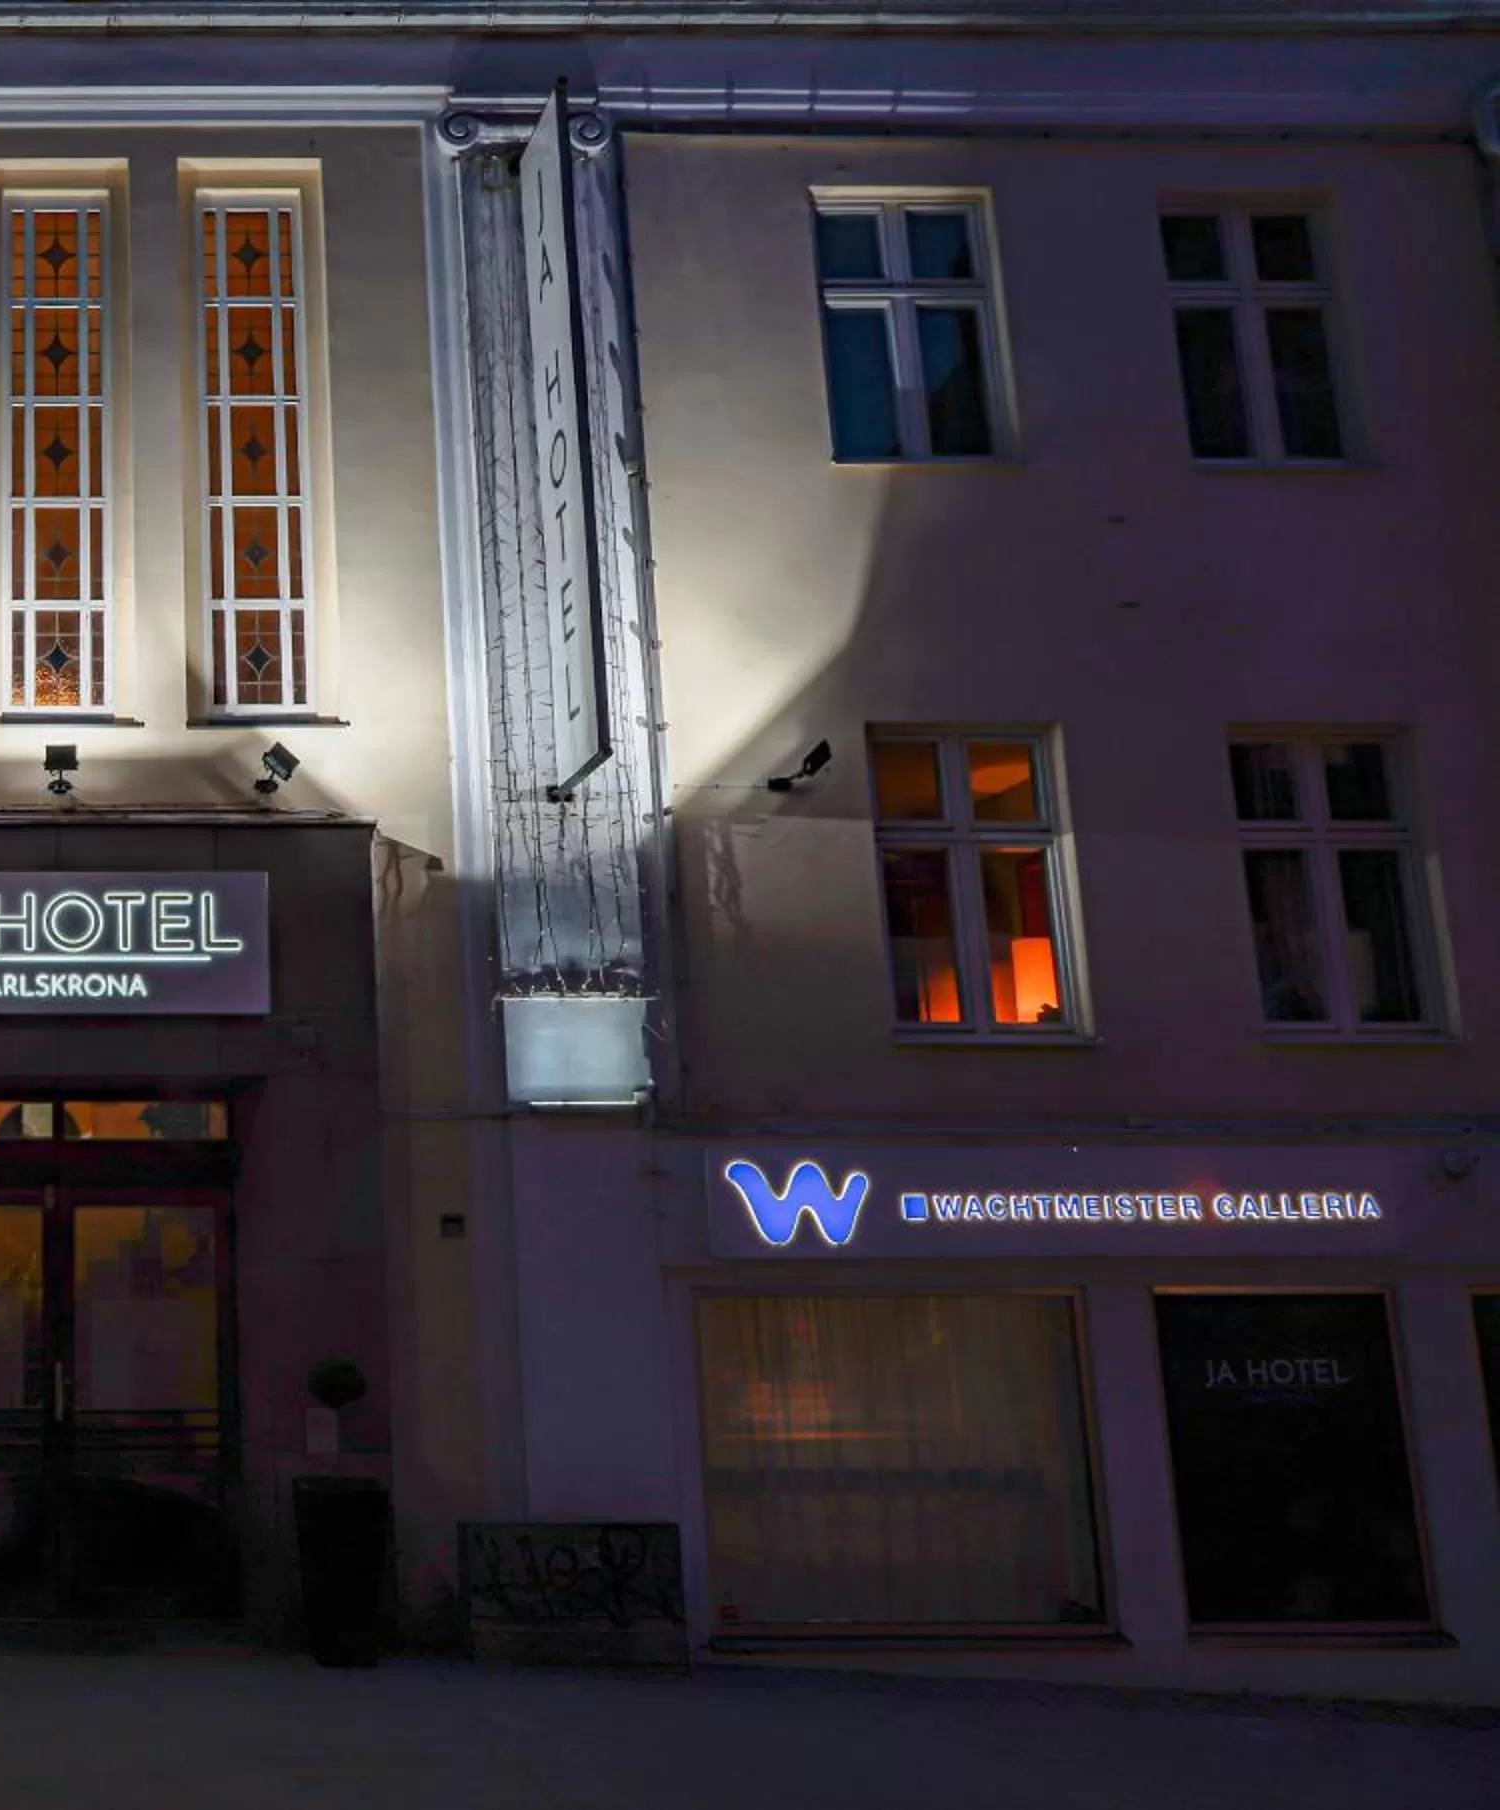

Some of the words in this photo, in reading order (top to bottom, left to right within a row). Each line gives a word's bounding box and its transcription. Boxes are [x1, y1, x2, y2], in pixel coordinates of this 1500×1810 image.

[537, 169, 553, 304] JA
[545, 348, 581, 721] HOTEL
[931, 1193, 1203, 1221] WACHTMEISTER
[1212, 1193, 1384, 1220] GALLERIA
[1204, 1358, 1238, 1389] JA
[1247, 1357, 1352, 1386] HOTEL
